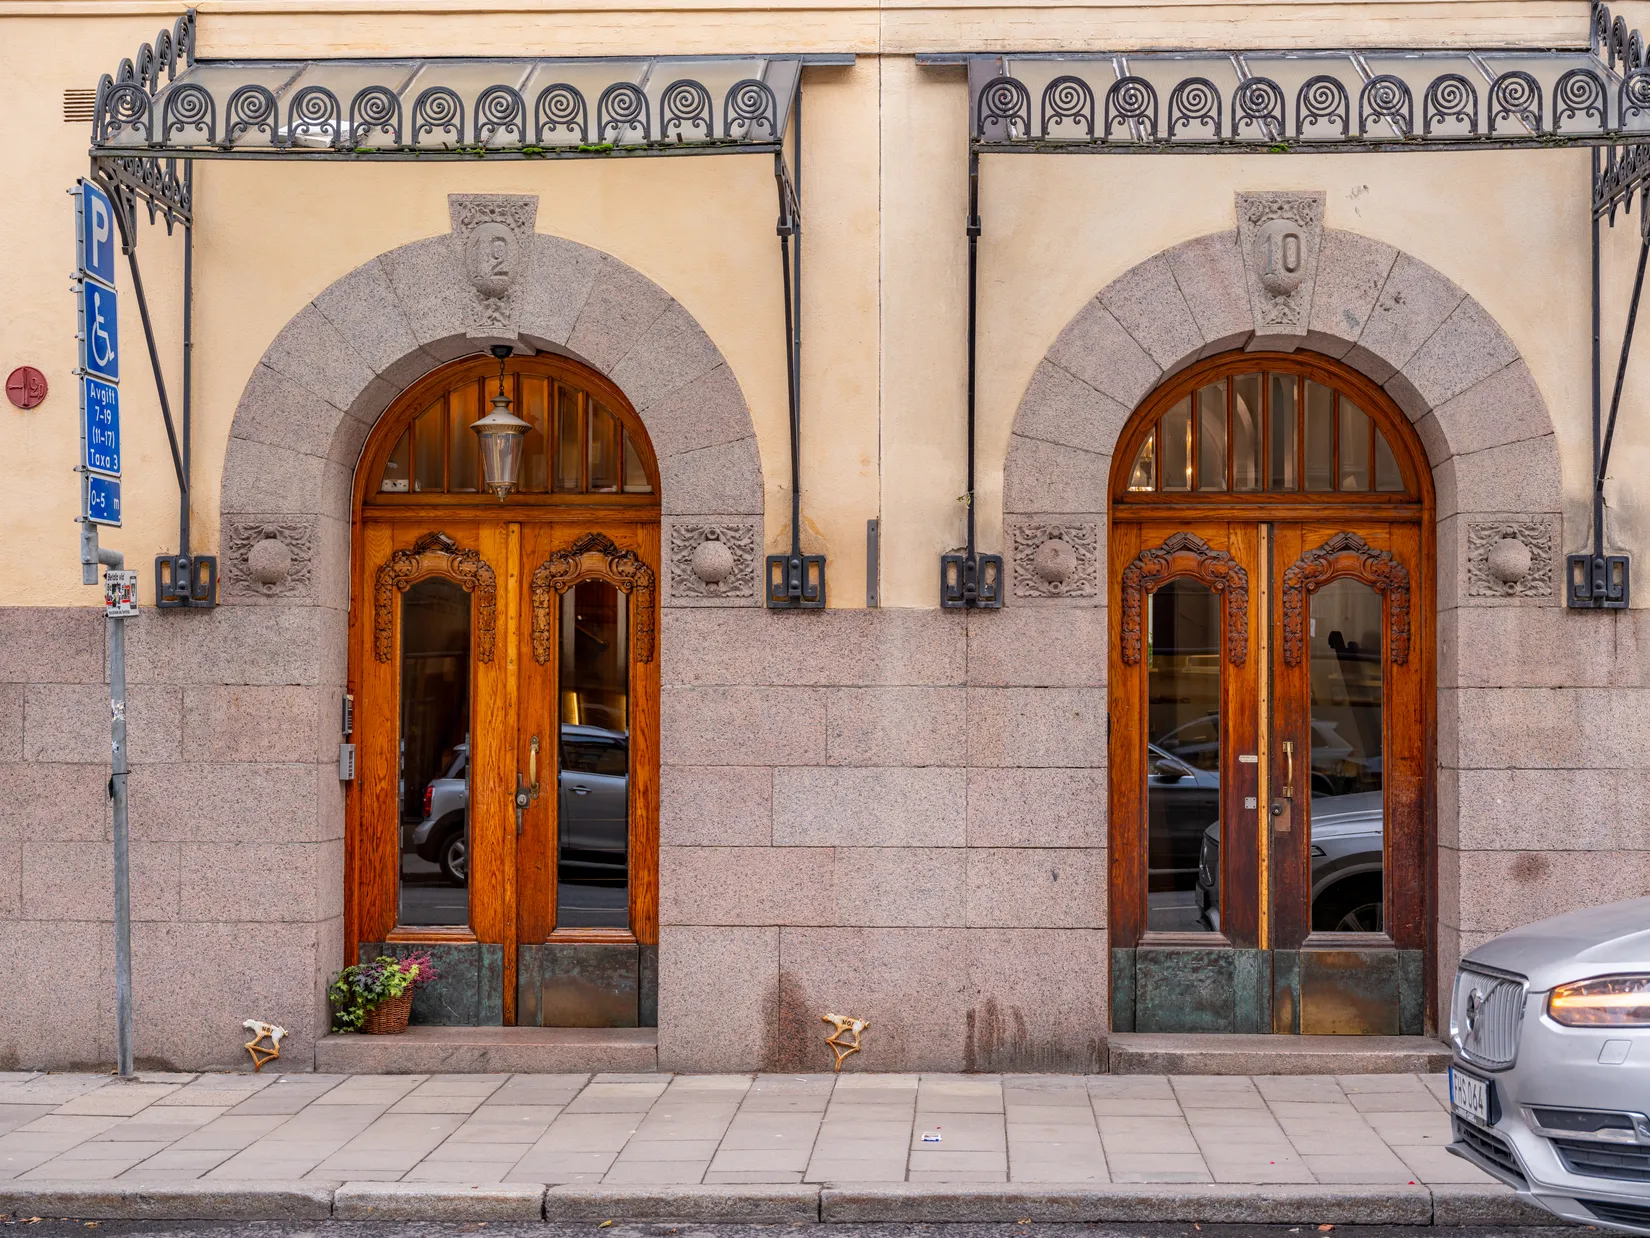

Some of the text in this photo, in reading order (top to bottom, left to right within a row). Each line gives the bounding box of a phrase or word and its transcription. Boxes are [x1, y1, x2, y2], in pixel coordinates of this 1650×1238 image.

[91, 194, 109, 268] P
[1262, 232, 1301, 275] 10
[90, 382, 115, 405] Avgift
[95, 405, 112, 425] 7-19
[92, 426, 115, 449] (11-17)
[90, 448, 118, 470] Taxa 3
[91, 489, 119, 510] 0-5 m
[1454, 1073, 1466, 1106] FHS
[1468, 1081, 1483, 1115] 064
